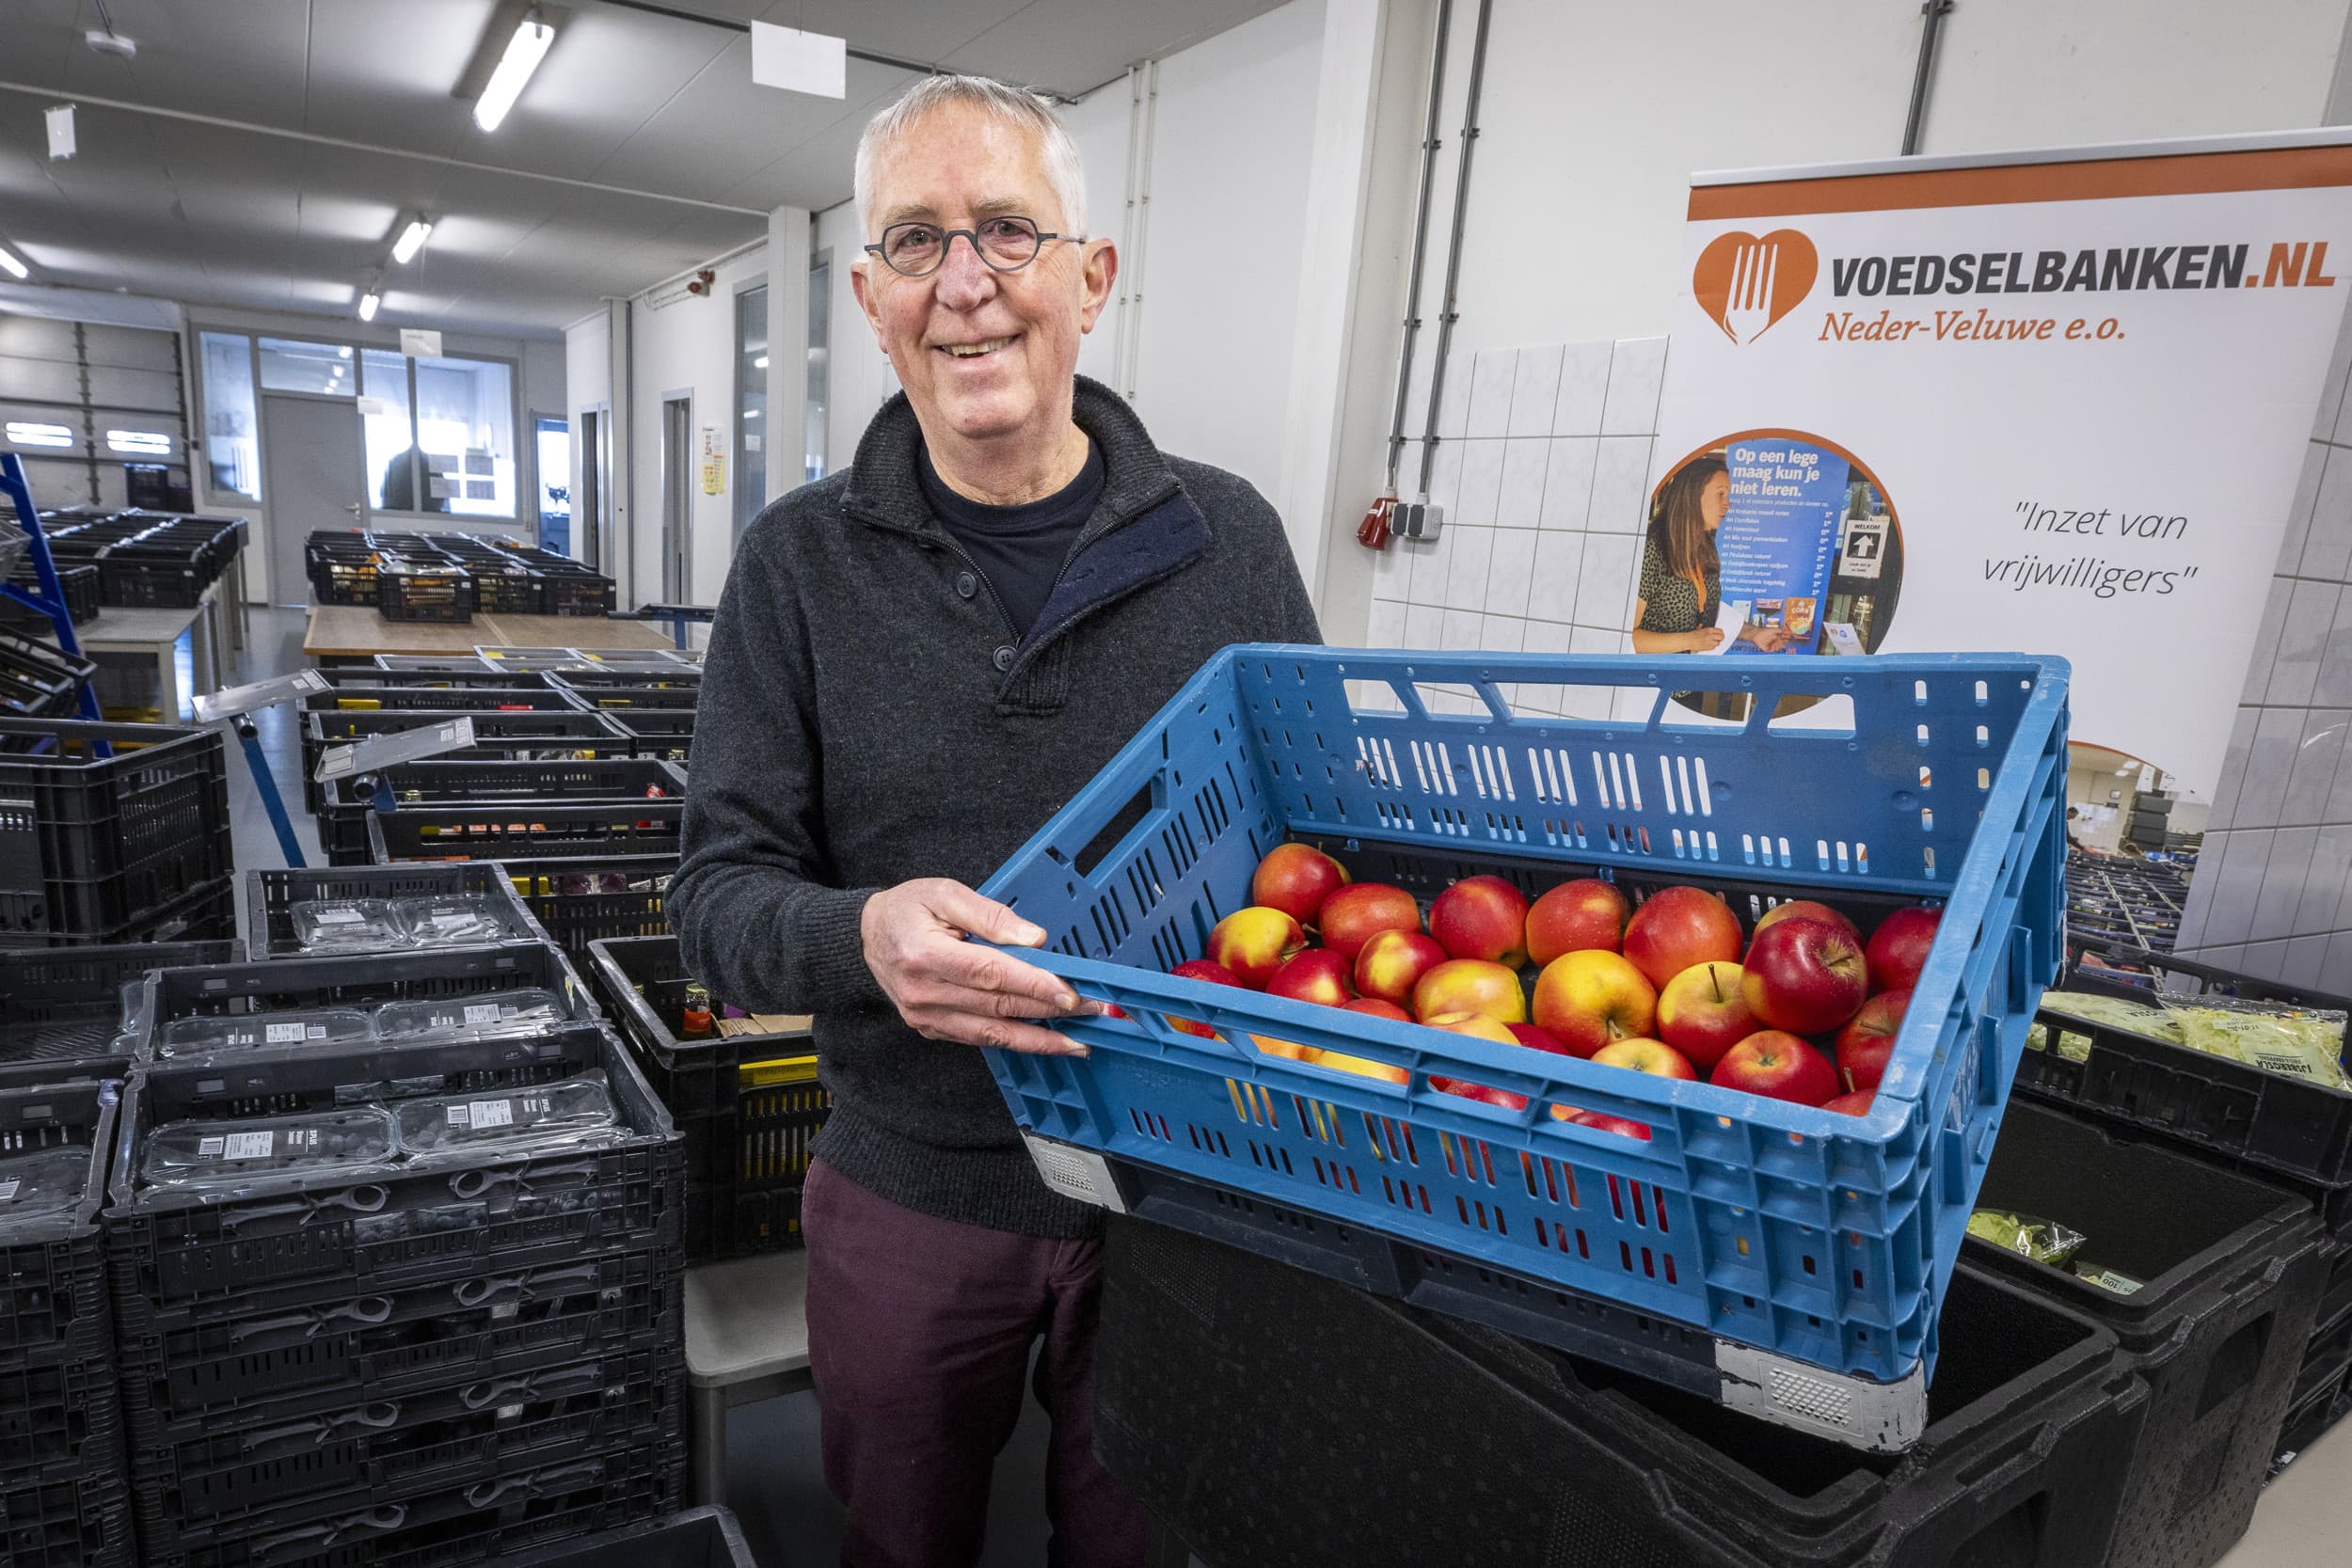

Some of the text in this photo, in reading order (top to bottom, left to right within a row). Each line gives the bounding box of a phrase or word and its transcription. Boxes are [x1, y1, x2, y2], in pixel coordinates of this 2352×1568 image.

[1832, 241, 2337, 297] VOEDSELBANKEN.NL
[1818, 308, 2126, 342] Neder-Veluwe e.o.
[1732, 465, 1820, 483] maag kun je
[1735, 448, 1819, 467] Op een lege
[1730, 481, 1802, 498] niet leren.
[2016, 501, 2188, 540] "Inzet van
[1984, 554, 2199, 599] vrijwilligers"
